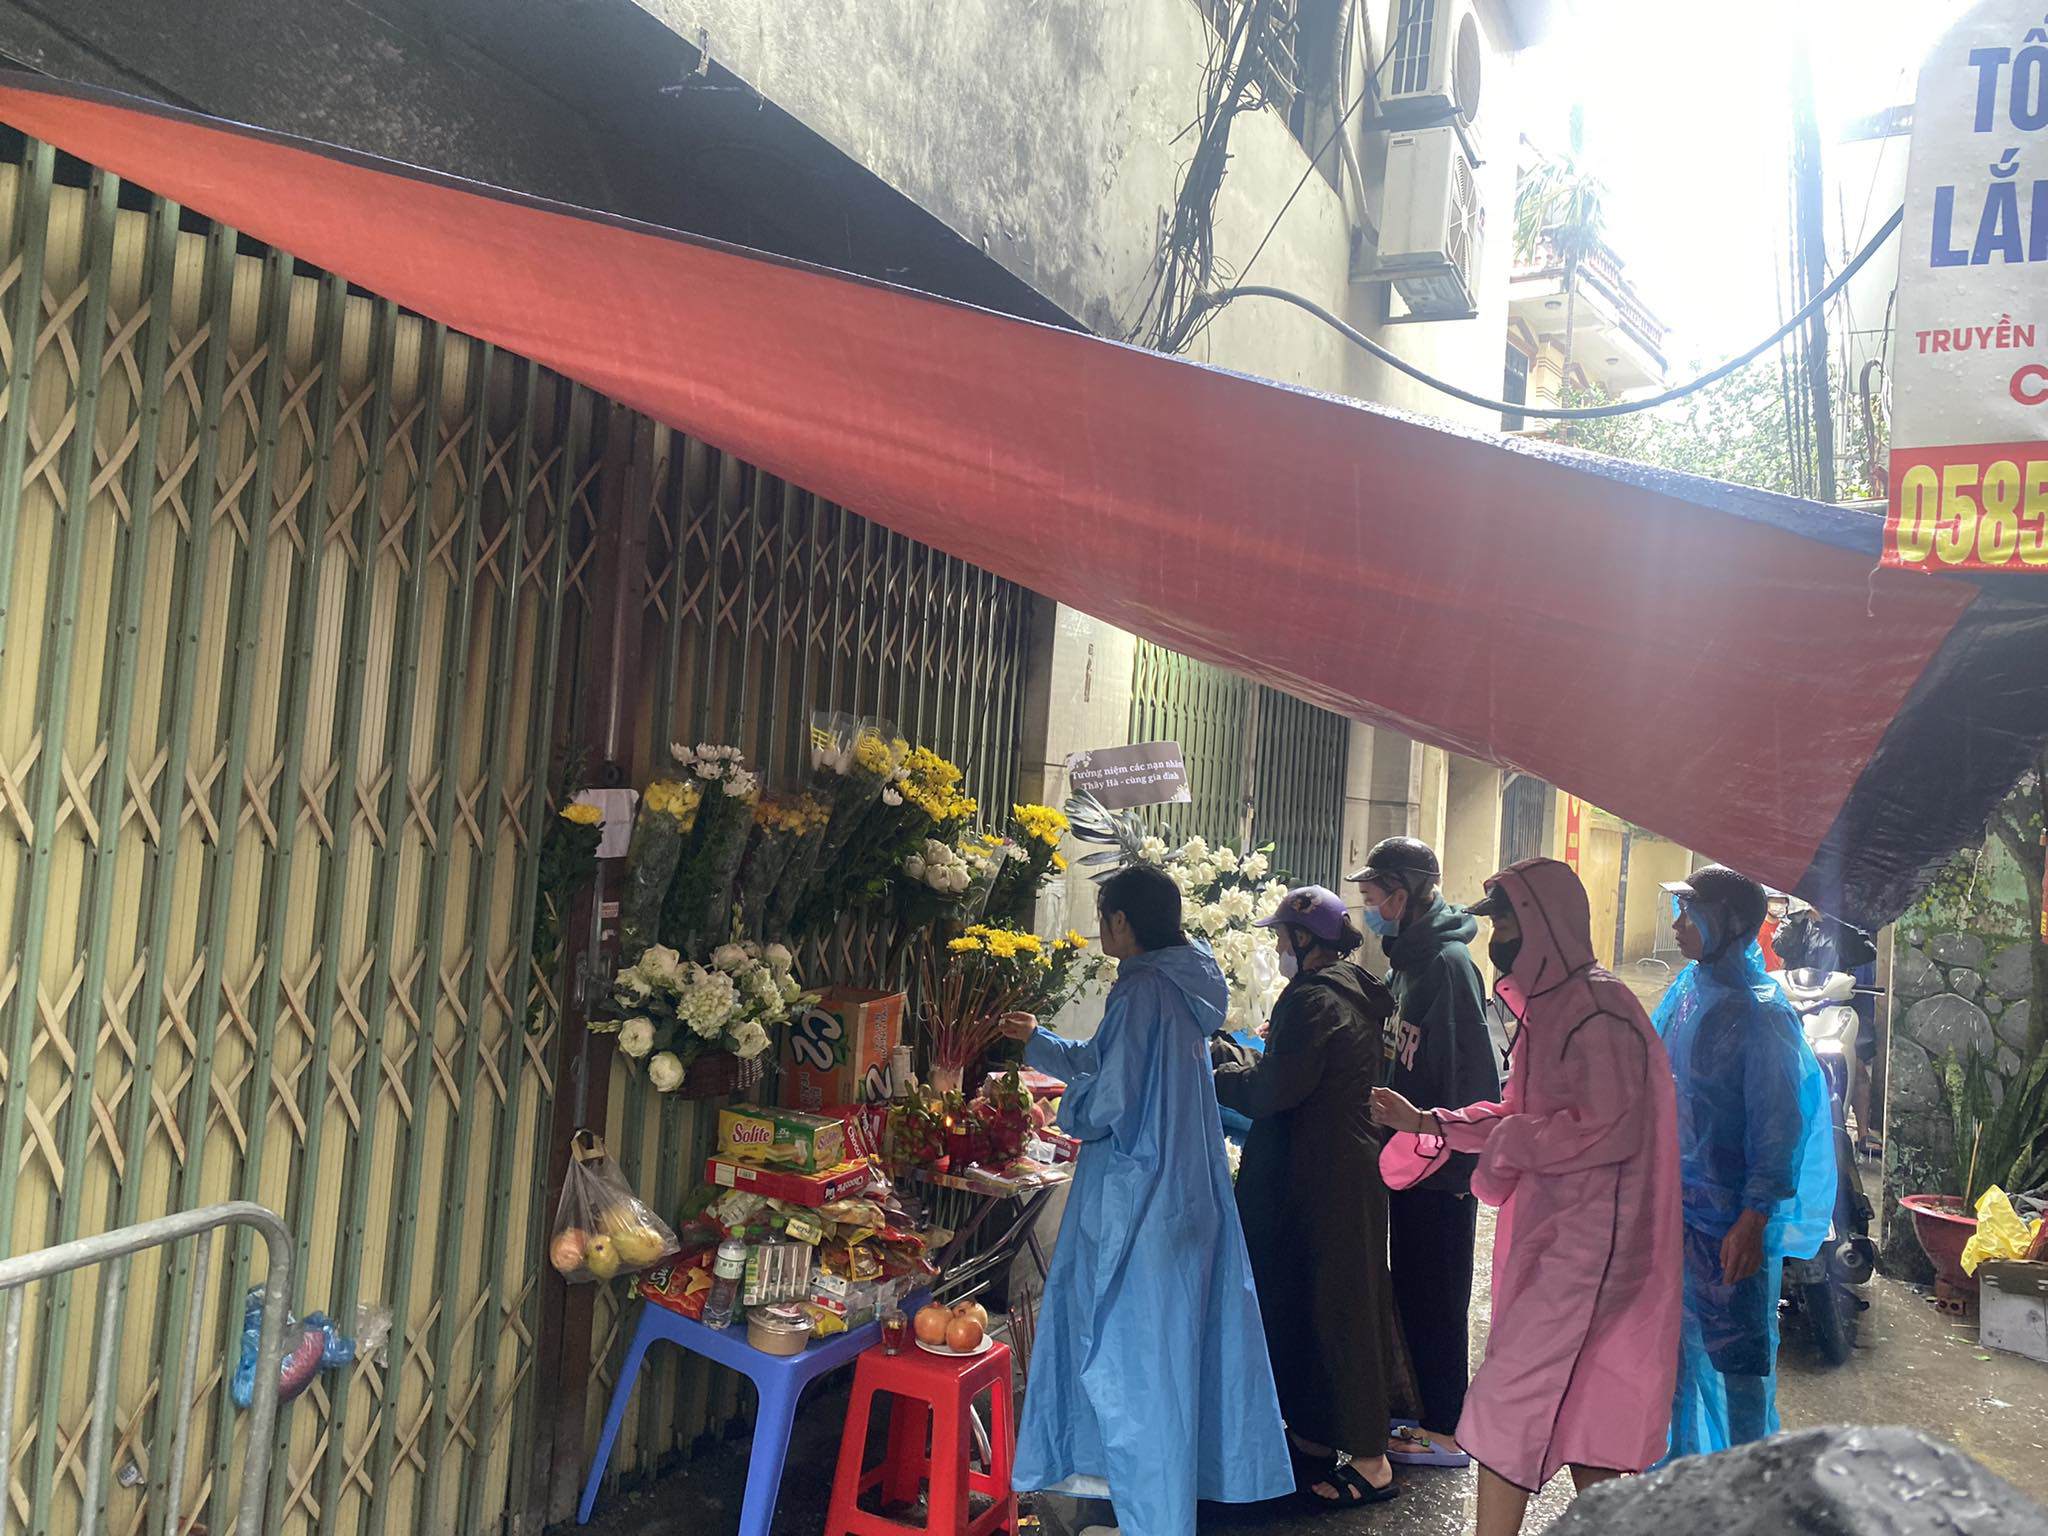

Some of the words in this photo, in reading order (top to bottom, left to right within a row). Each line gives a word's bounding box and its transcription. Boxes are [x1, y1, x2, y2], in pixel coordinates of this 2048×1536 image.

[1915, 313, 2035, 354] TRUYỀN
[1897, 460, 2048, 564] 0585
[1071, 768, 1103, 780] Tưởng
[1104, 765, 1128, 776] niệm
[1129, 763, 1146, 772] các
[1146, 761, 1164, 771] nạn
[1125, 775, 1147, 785] cùng
[1147, 773, 1162, 784] gia
[790, 1007, 842, 1071] C2
[732, 1120, 771, 1145] Solite
